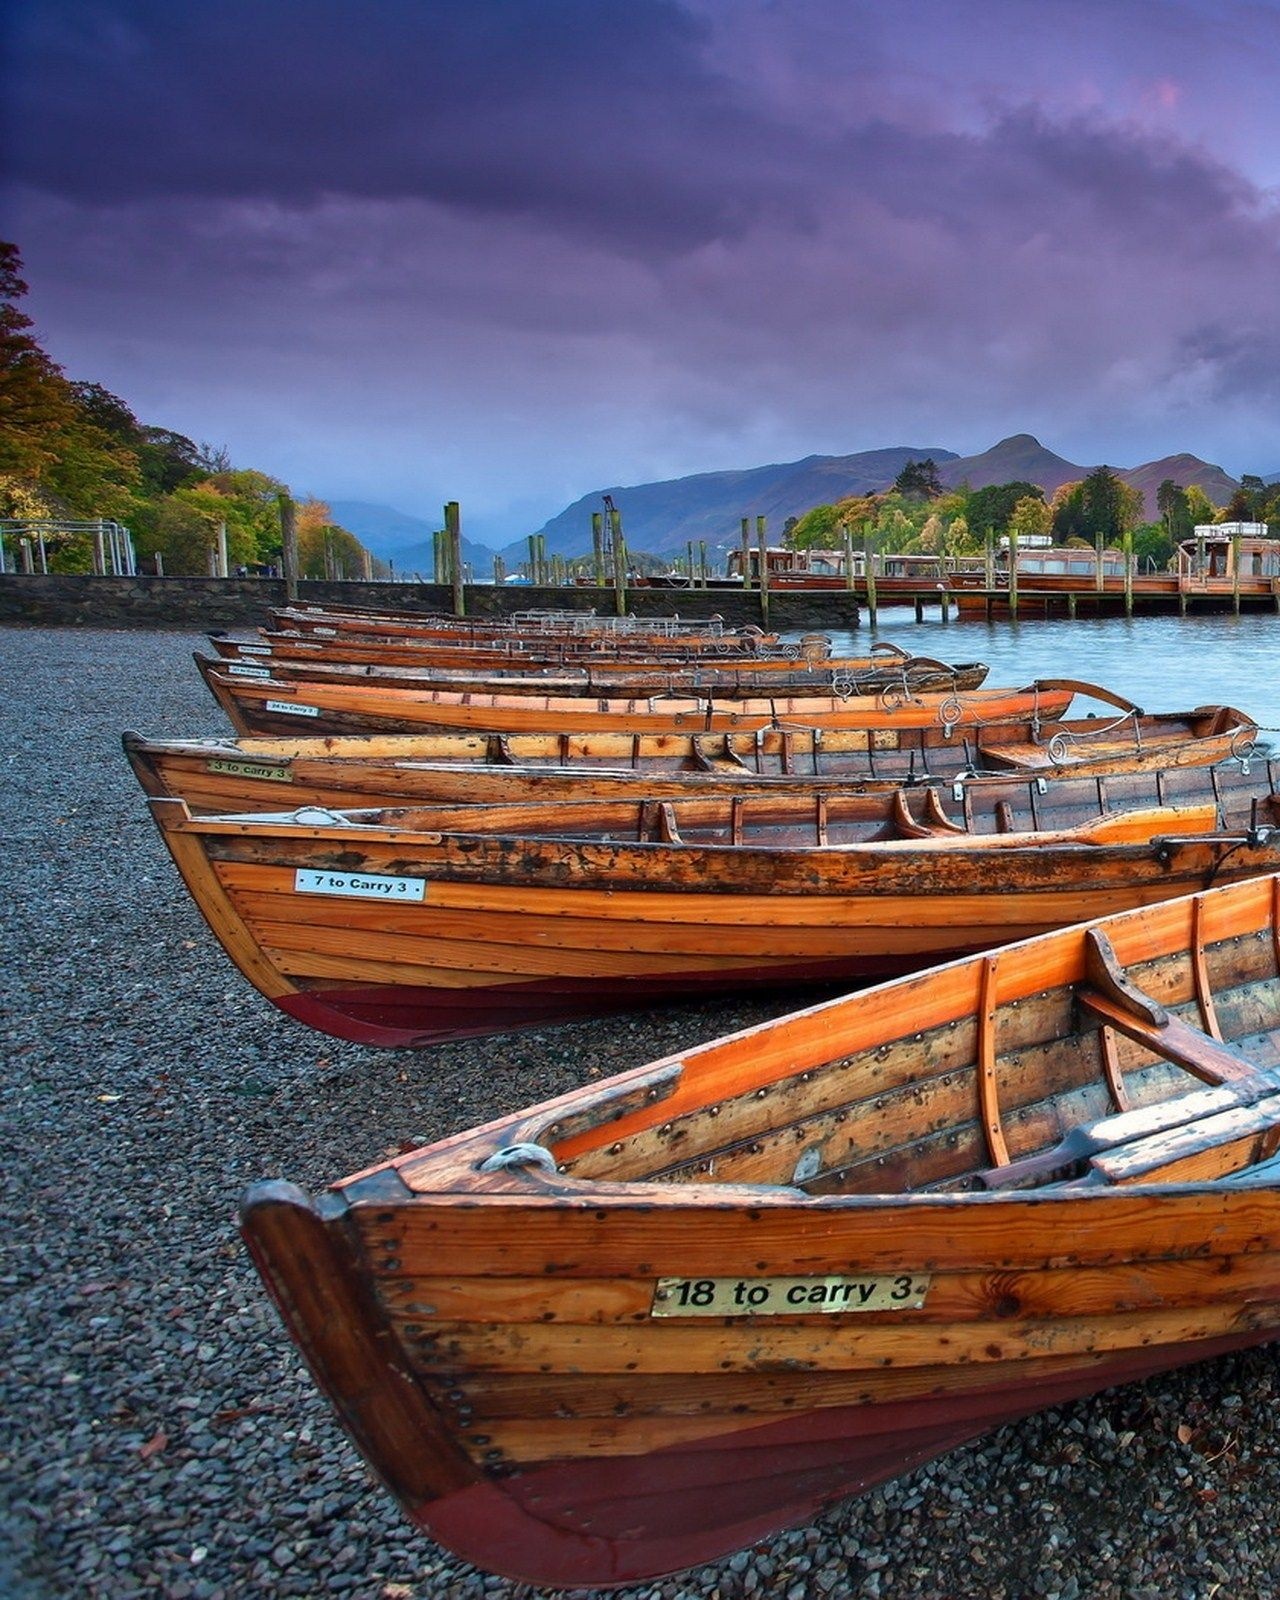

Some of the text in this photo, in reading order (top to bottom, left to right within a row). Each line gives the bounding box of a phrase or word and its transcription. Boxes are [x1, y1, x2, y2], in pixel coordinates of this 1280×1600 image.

[226, 762, 239, 772] to
[243, 765, 273, 777] carry
[277, 769, 286, 778] 3
[314, 876, 407, 893] 7 to Carry 3
[675, 1276, 913, 1306] 18 to carry 3
